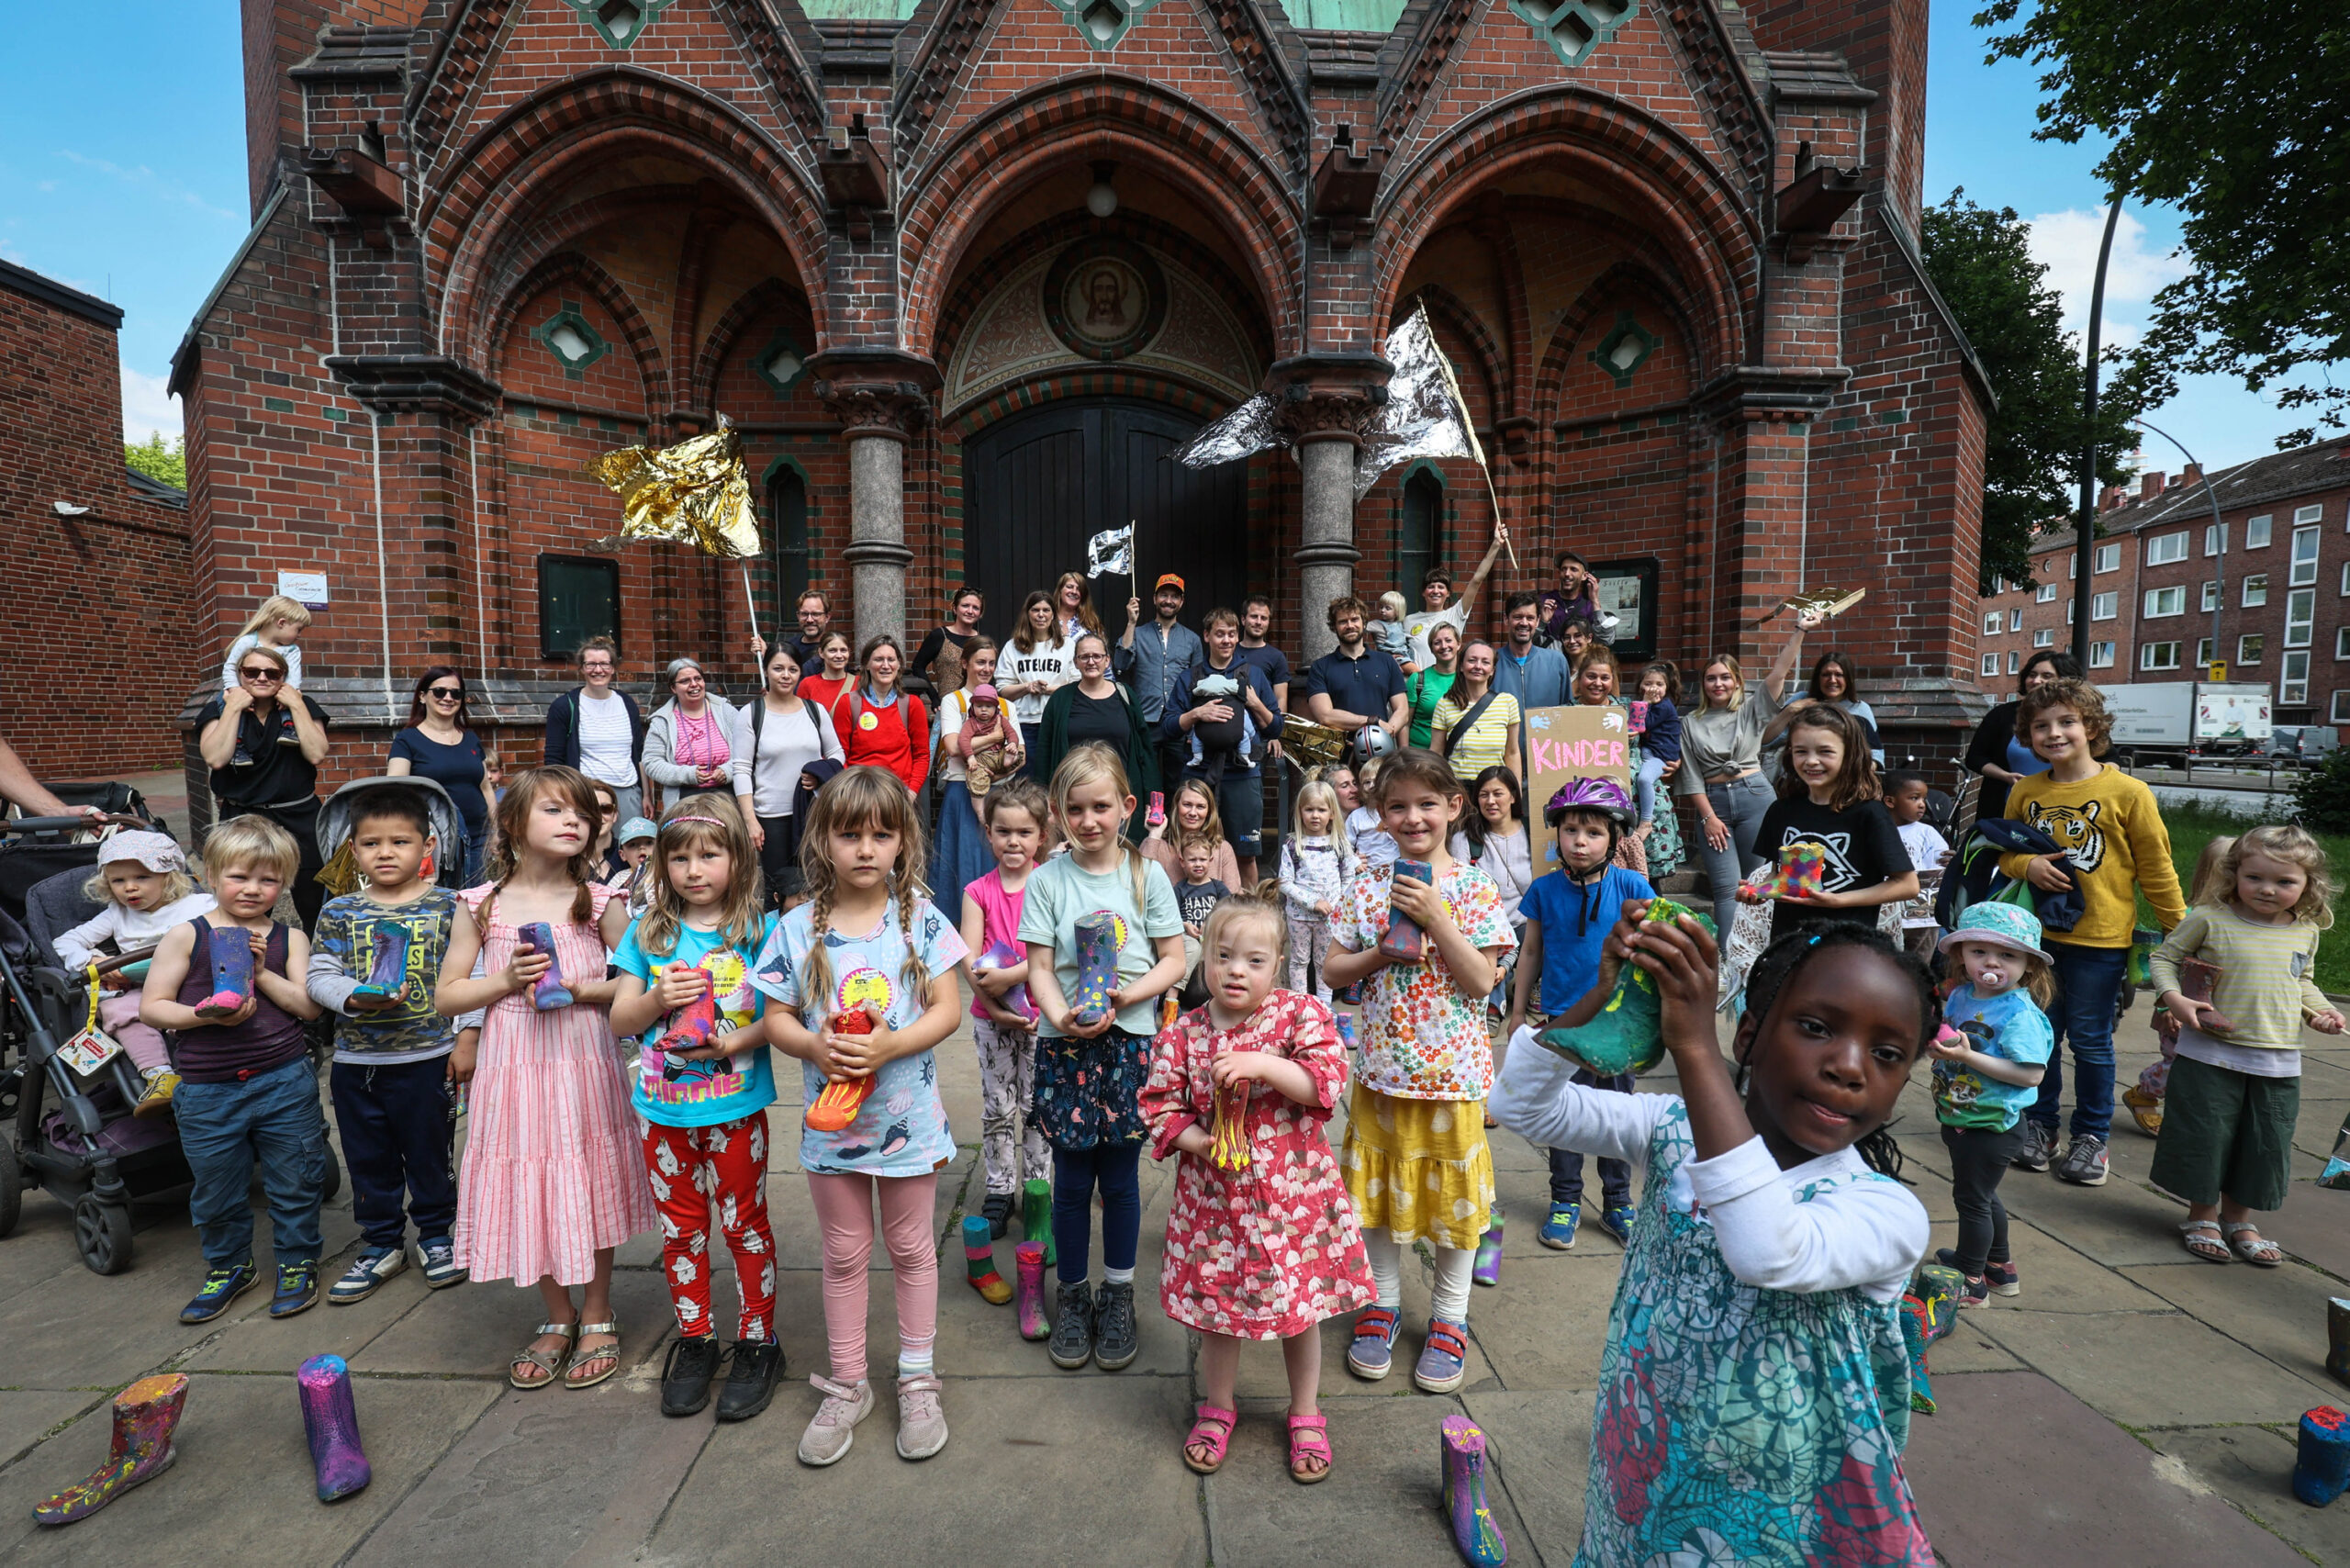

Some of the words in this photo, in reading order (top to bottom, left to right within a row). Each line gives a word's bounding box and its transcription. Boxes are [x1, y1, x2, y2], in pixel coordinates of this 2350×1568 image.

[1017, 657, 1062, 674] ATELIER
[1530, 737, 1625, 774] KINDER
[643, 1072, 745, 1104] Minnie
